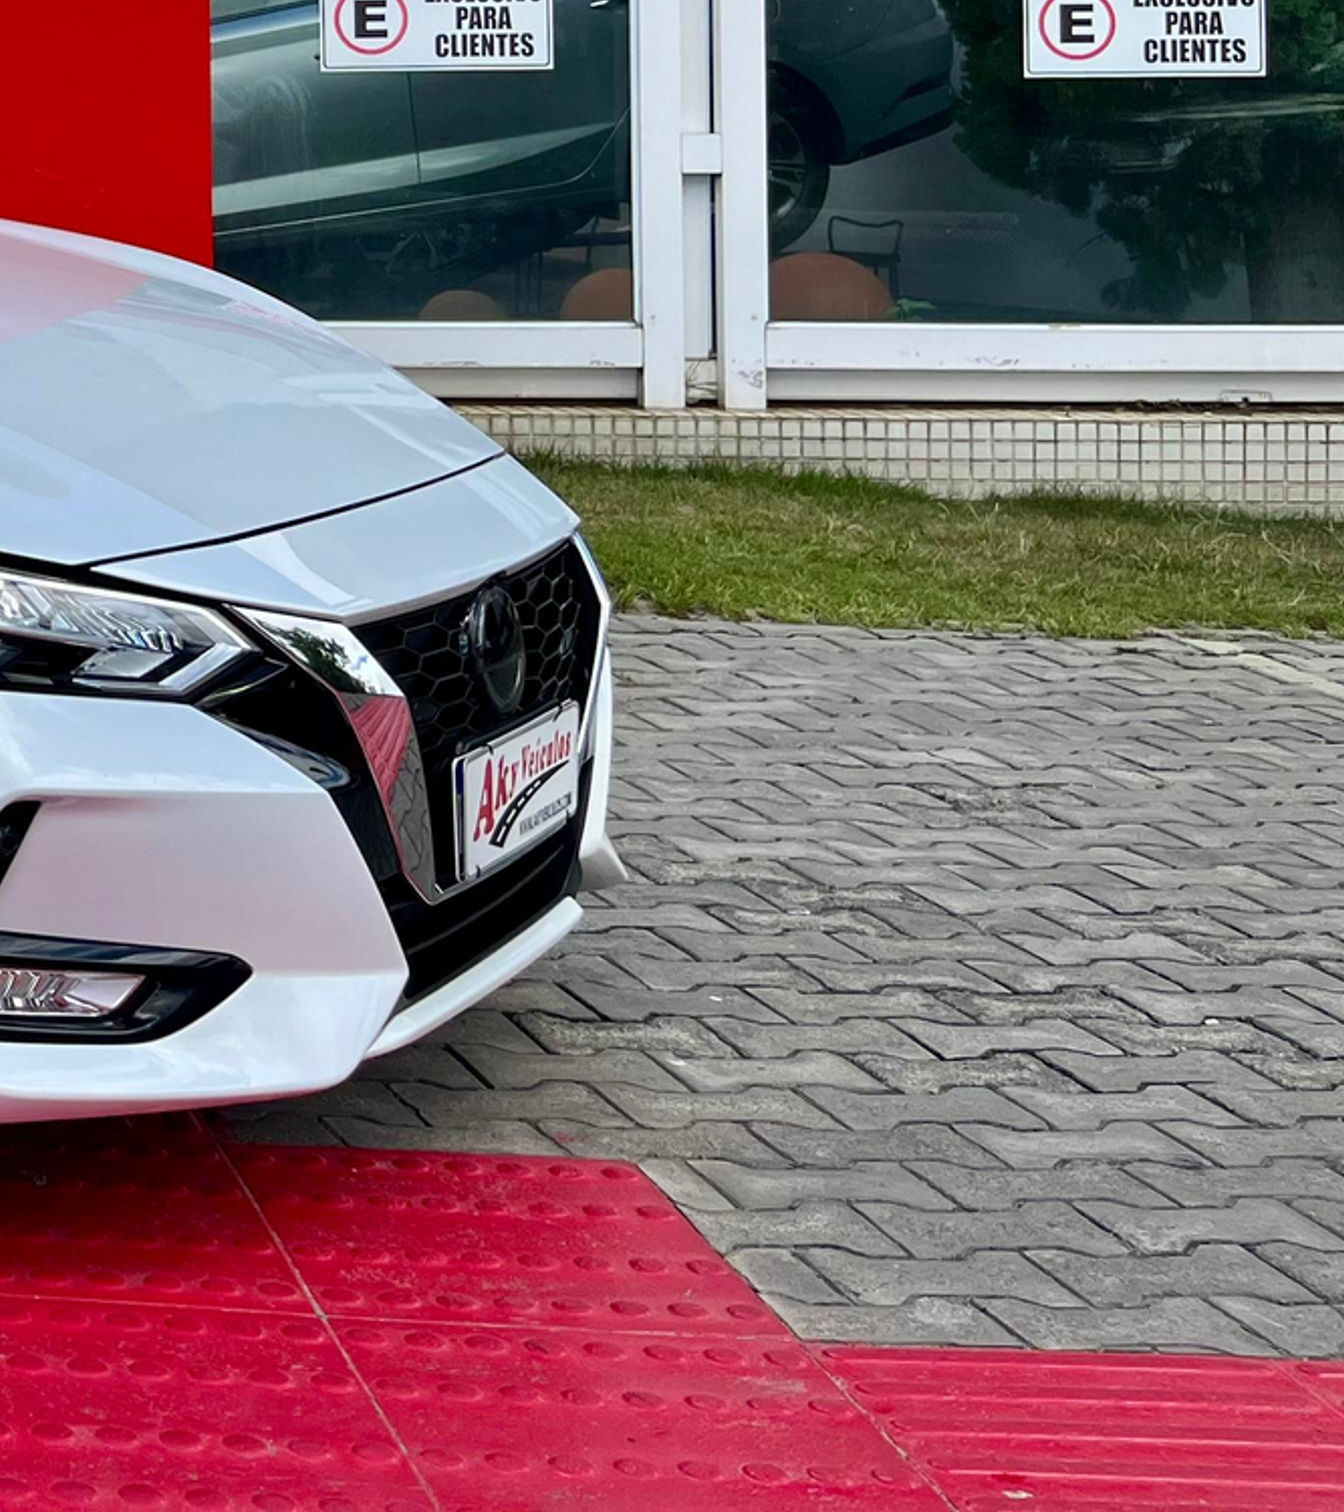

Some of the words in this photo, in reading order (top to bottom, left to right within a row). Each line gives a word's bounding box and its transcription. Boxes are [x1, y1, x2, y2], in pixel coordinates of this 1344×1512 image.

[353, 0, 389, 39] E
[456, 6, 513, 30] PARA
[1059, 4, 1095, 44] E
[1165, 12, 1224, 36] PARA
[435, 33, 535, 58] CLIENTES
[1144, 39, 1247, 63] CLIENTES
[472, 755, 520, 842] Aky
[520, 729, 572, 782] Veículos
